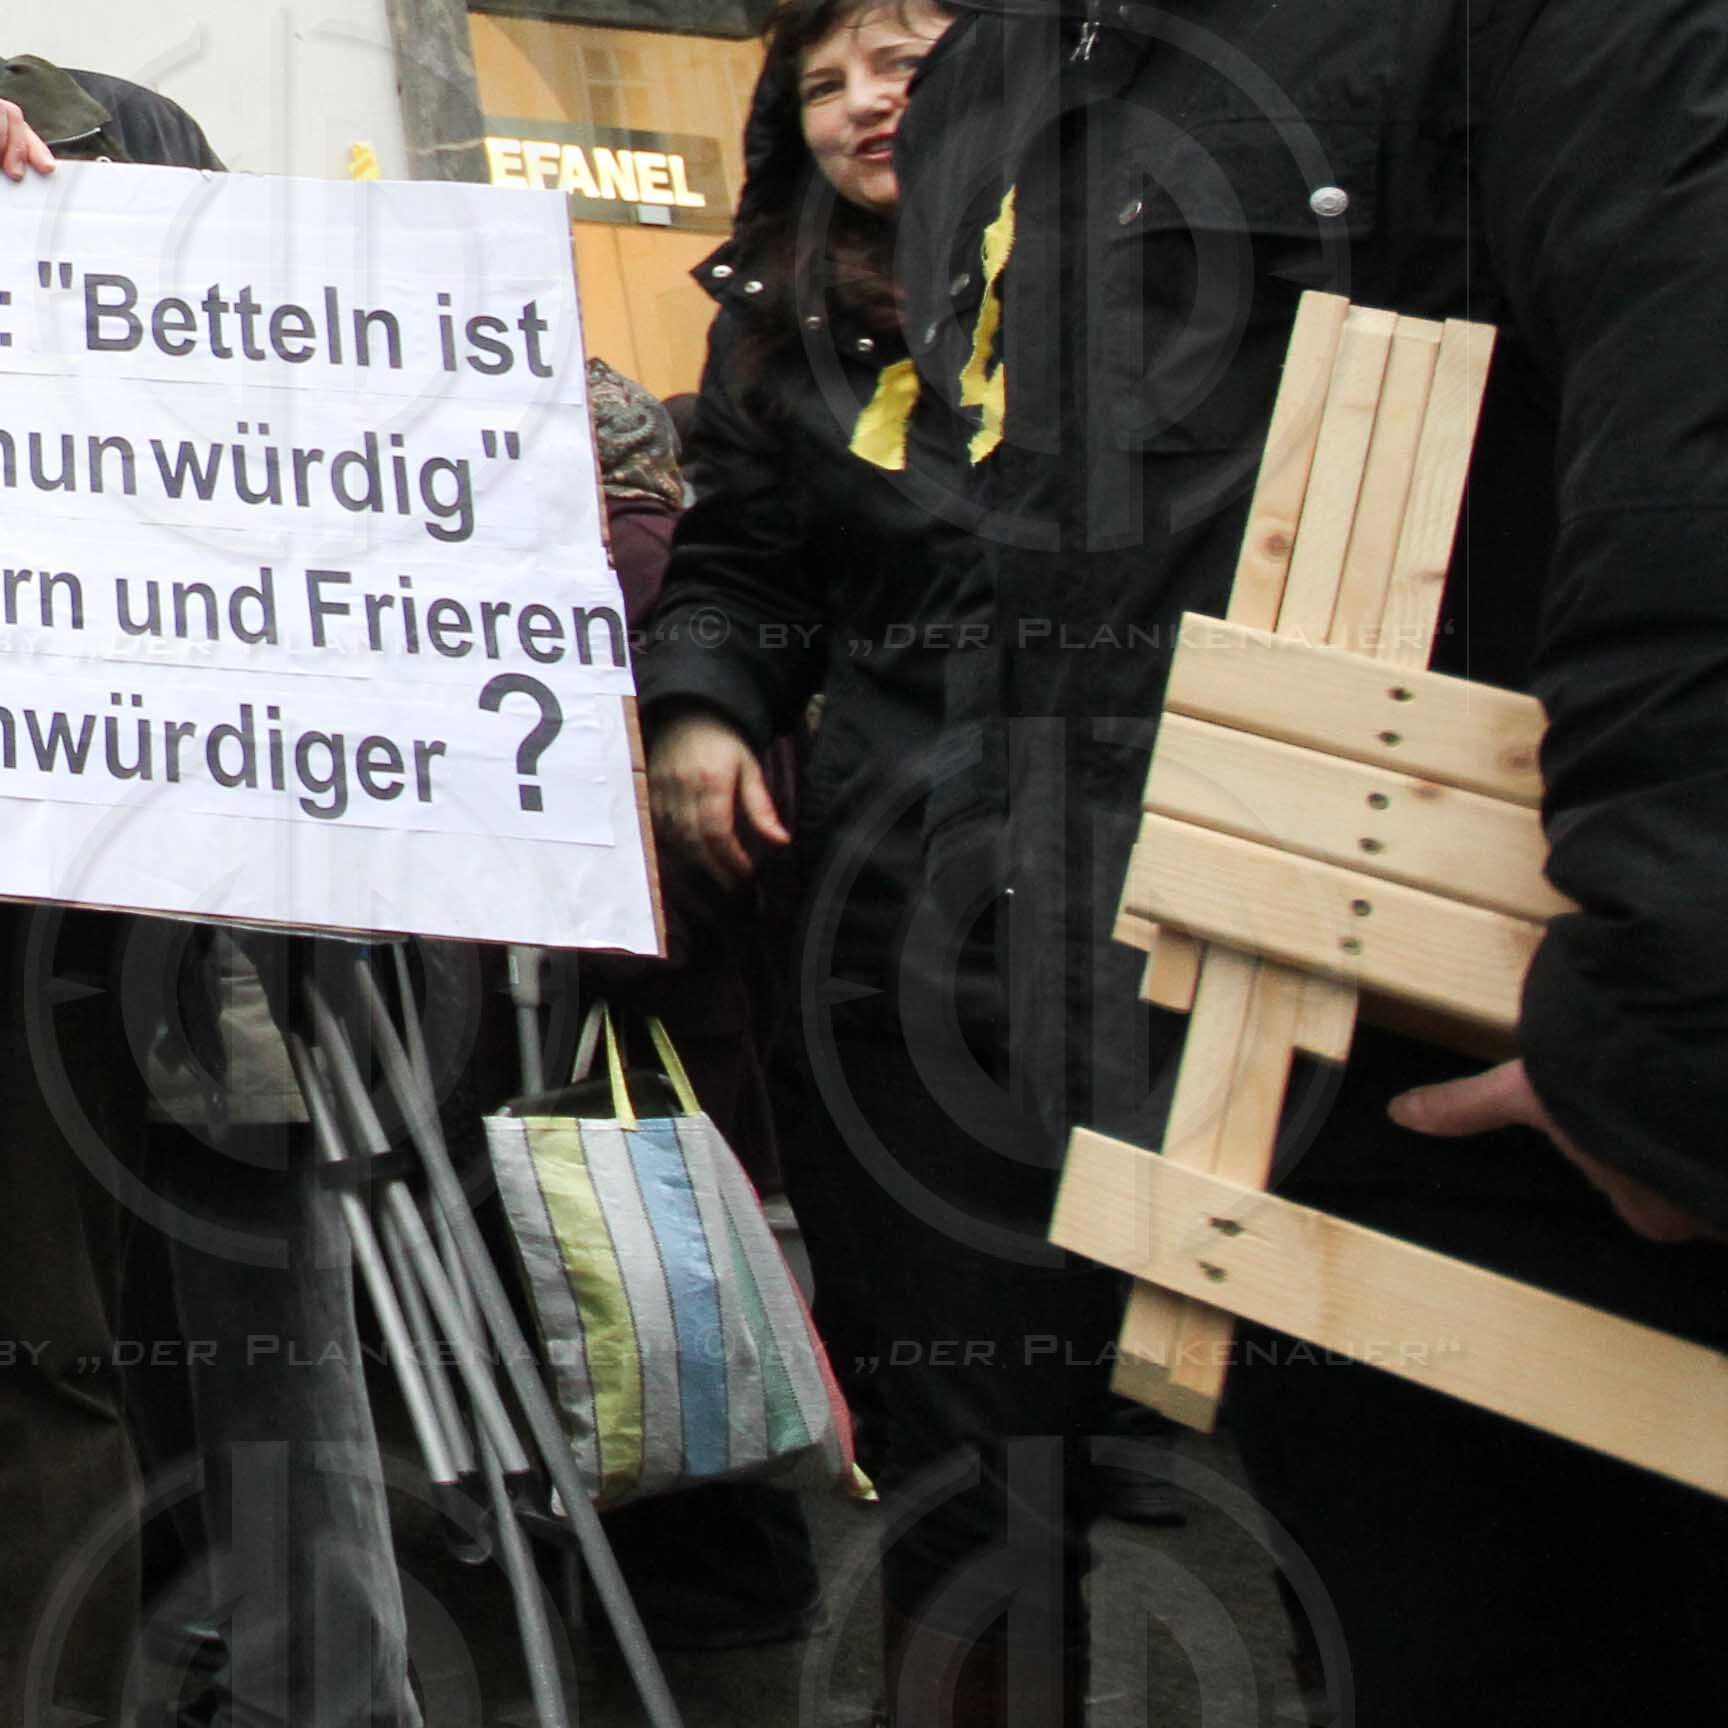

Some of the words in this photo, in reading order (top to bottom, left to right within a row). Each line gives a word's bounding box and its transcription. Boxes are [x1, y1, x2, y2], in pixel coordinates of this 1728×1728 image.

[485, 136, 706, 208] EFANEL
[37, 261, 403, 370] "Betteln
[437, 292, 553, 378] ist
[115, 567, 278, 646] und
[304, 569, 627, 668] Frieren
[479, 672, 565, 812] ?
